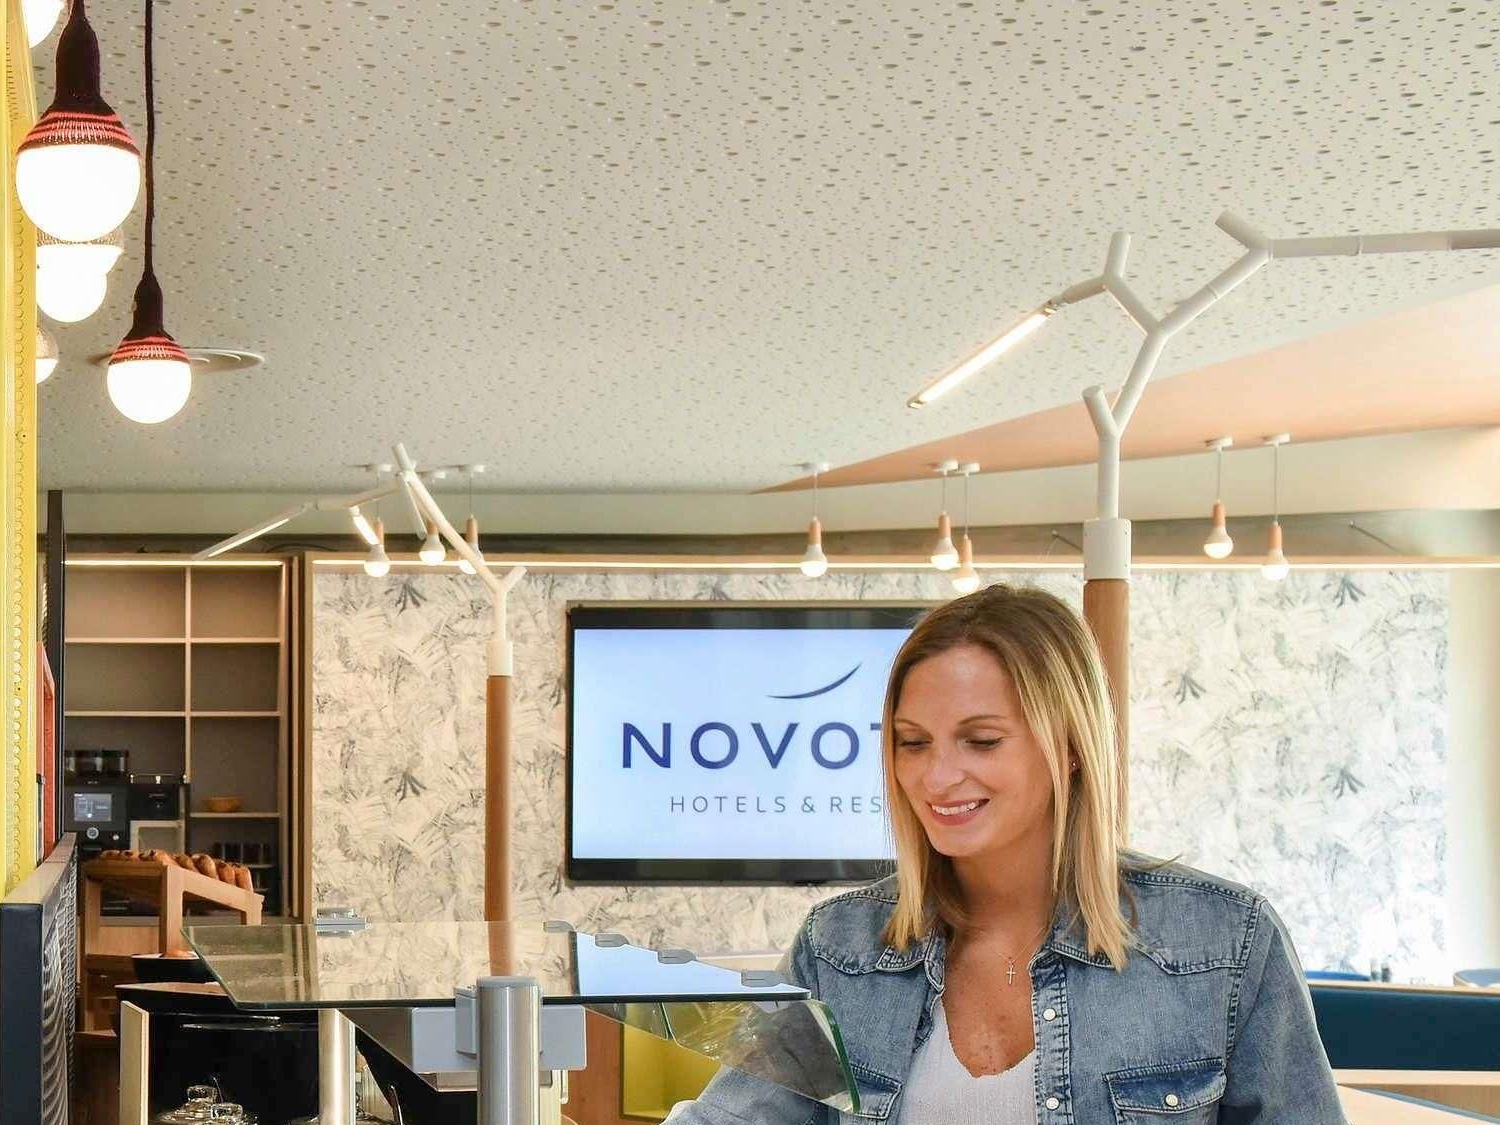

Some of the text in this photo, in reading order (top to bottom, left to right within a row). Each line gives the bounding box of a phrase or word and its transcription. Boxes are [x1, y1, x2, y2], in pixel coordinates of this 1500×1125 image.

[622, 721, 882, 769] NOVO
[670, 795, 882, 814] HOTELS & RES
